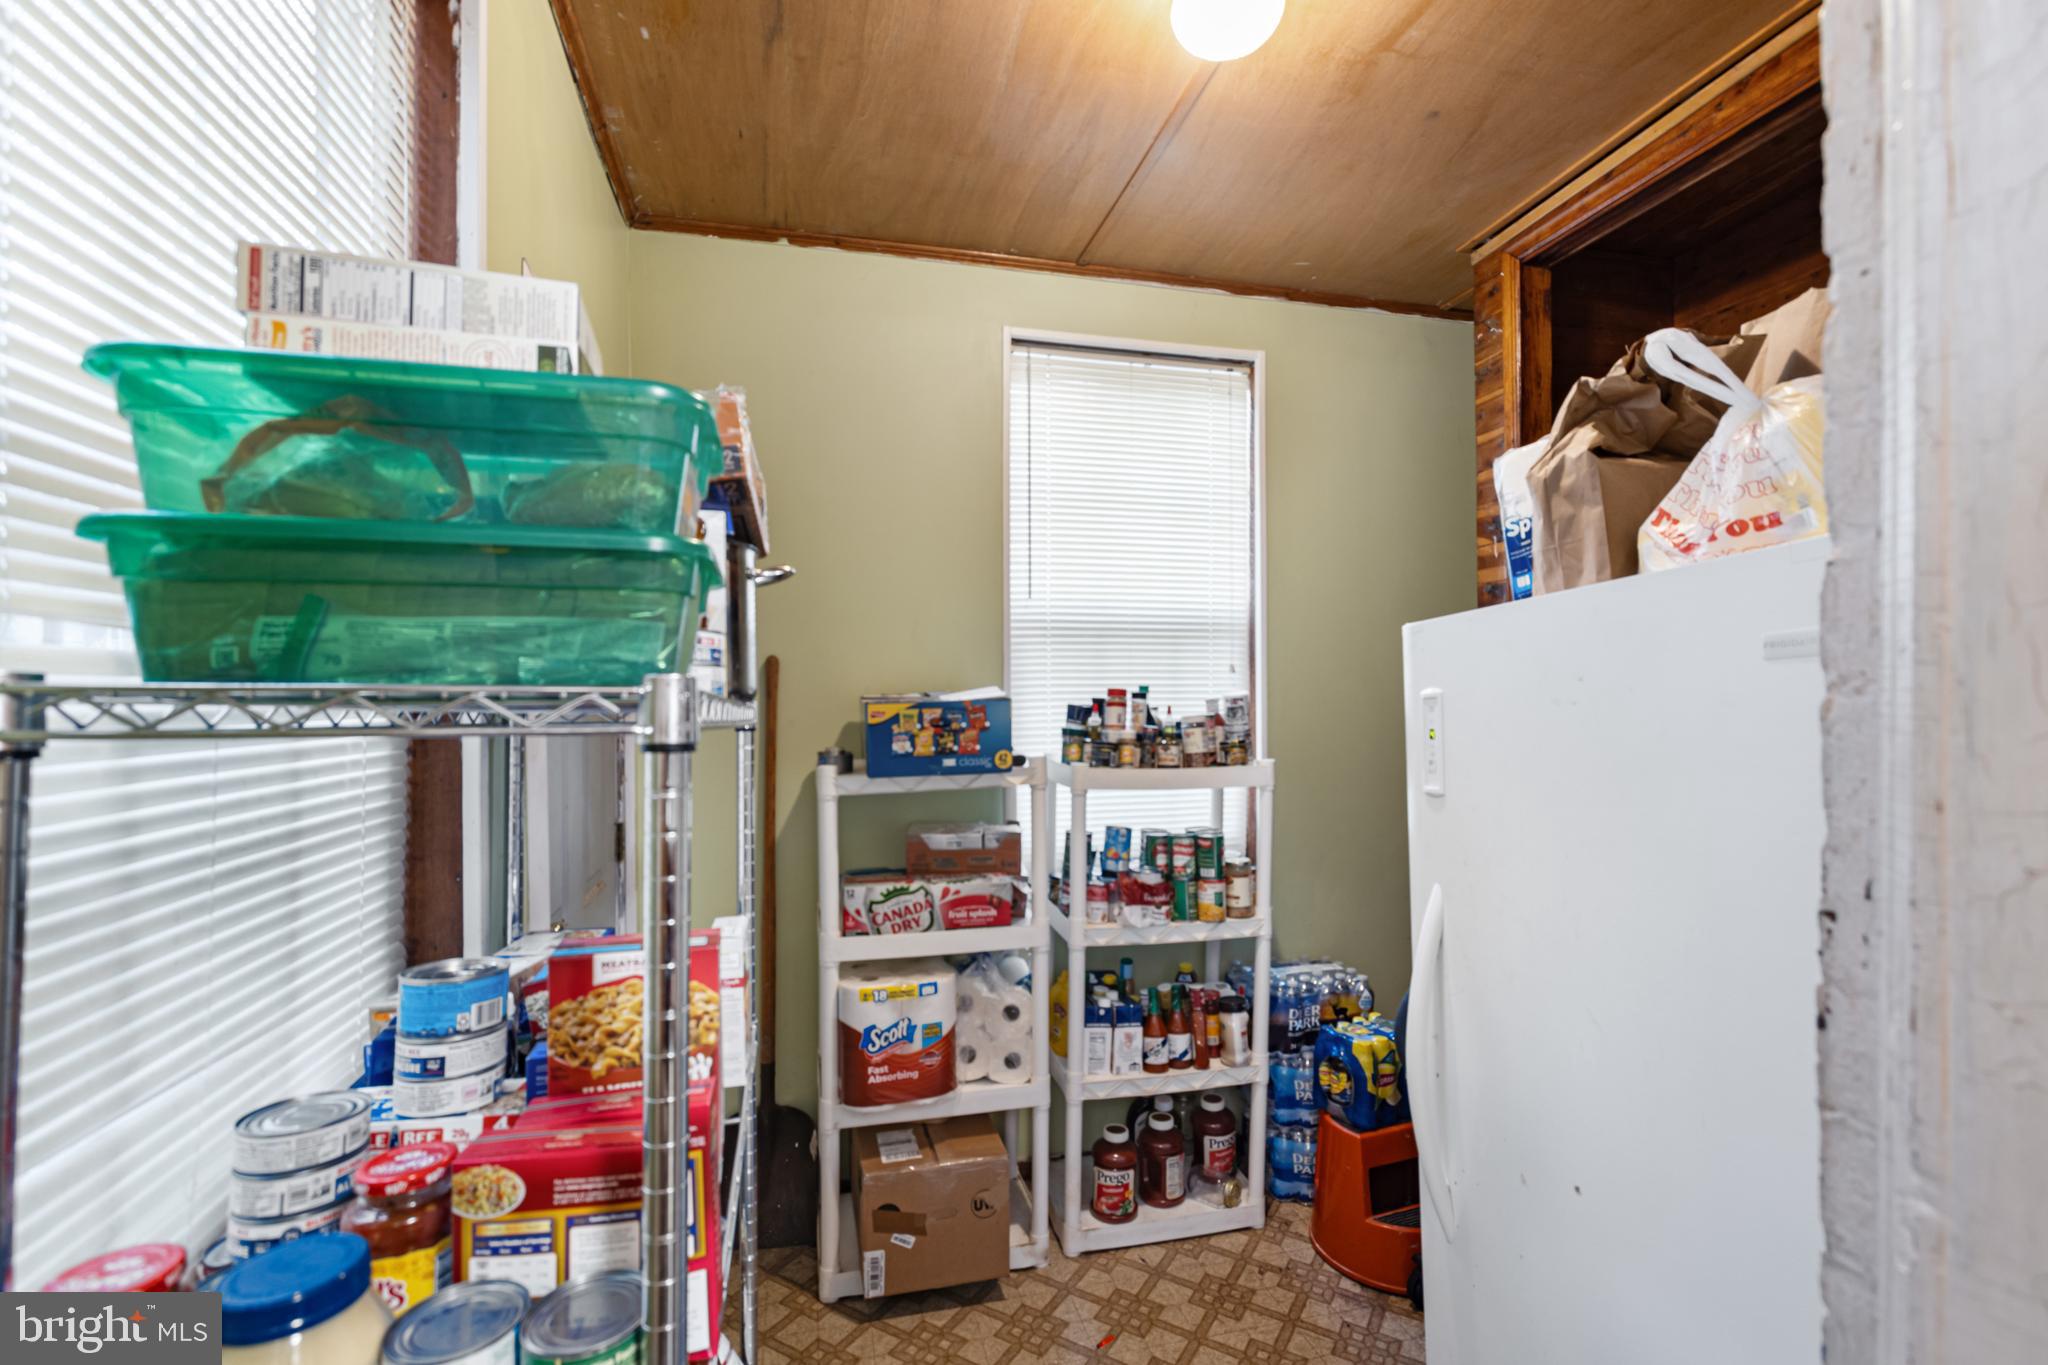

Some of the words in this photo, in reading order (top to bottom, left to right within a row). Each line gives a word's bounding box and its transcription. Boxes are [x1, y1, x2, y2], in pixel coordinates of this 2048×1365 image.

[846, 888, 855, 898] 12
[871, 898, 933, 928] CANADA
[948, 909, 968, 919] fruit
[969, 907, 998, 920] splash
[890, 916, 922, 935] DRY
[872, 990, 888, 1003] 18
[1289, 1017, 1320, 1032] PARK
[867, 1017, 909, 1053] Scott
[867, 1065, 889, 1076] Fast
[867, 1070, 919, 1085] Absorbing
[1097, 1169, 1130, 1186] Prego
